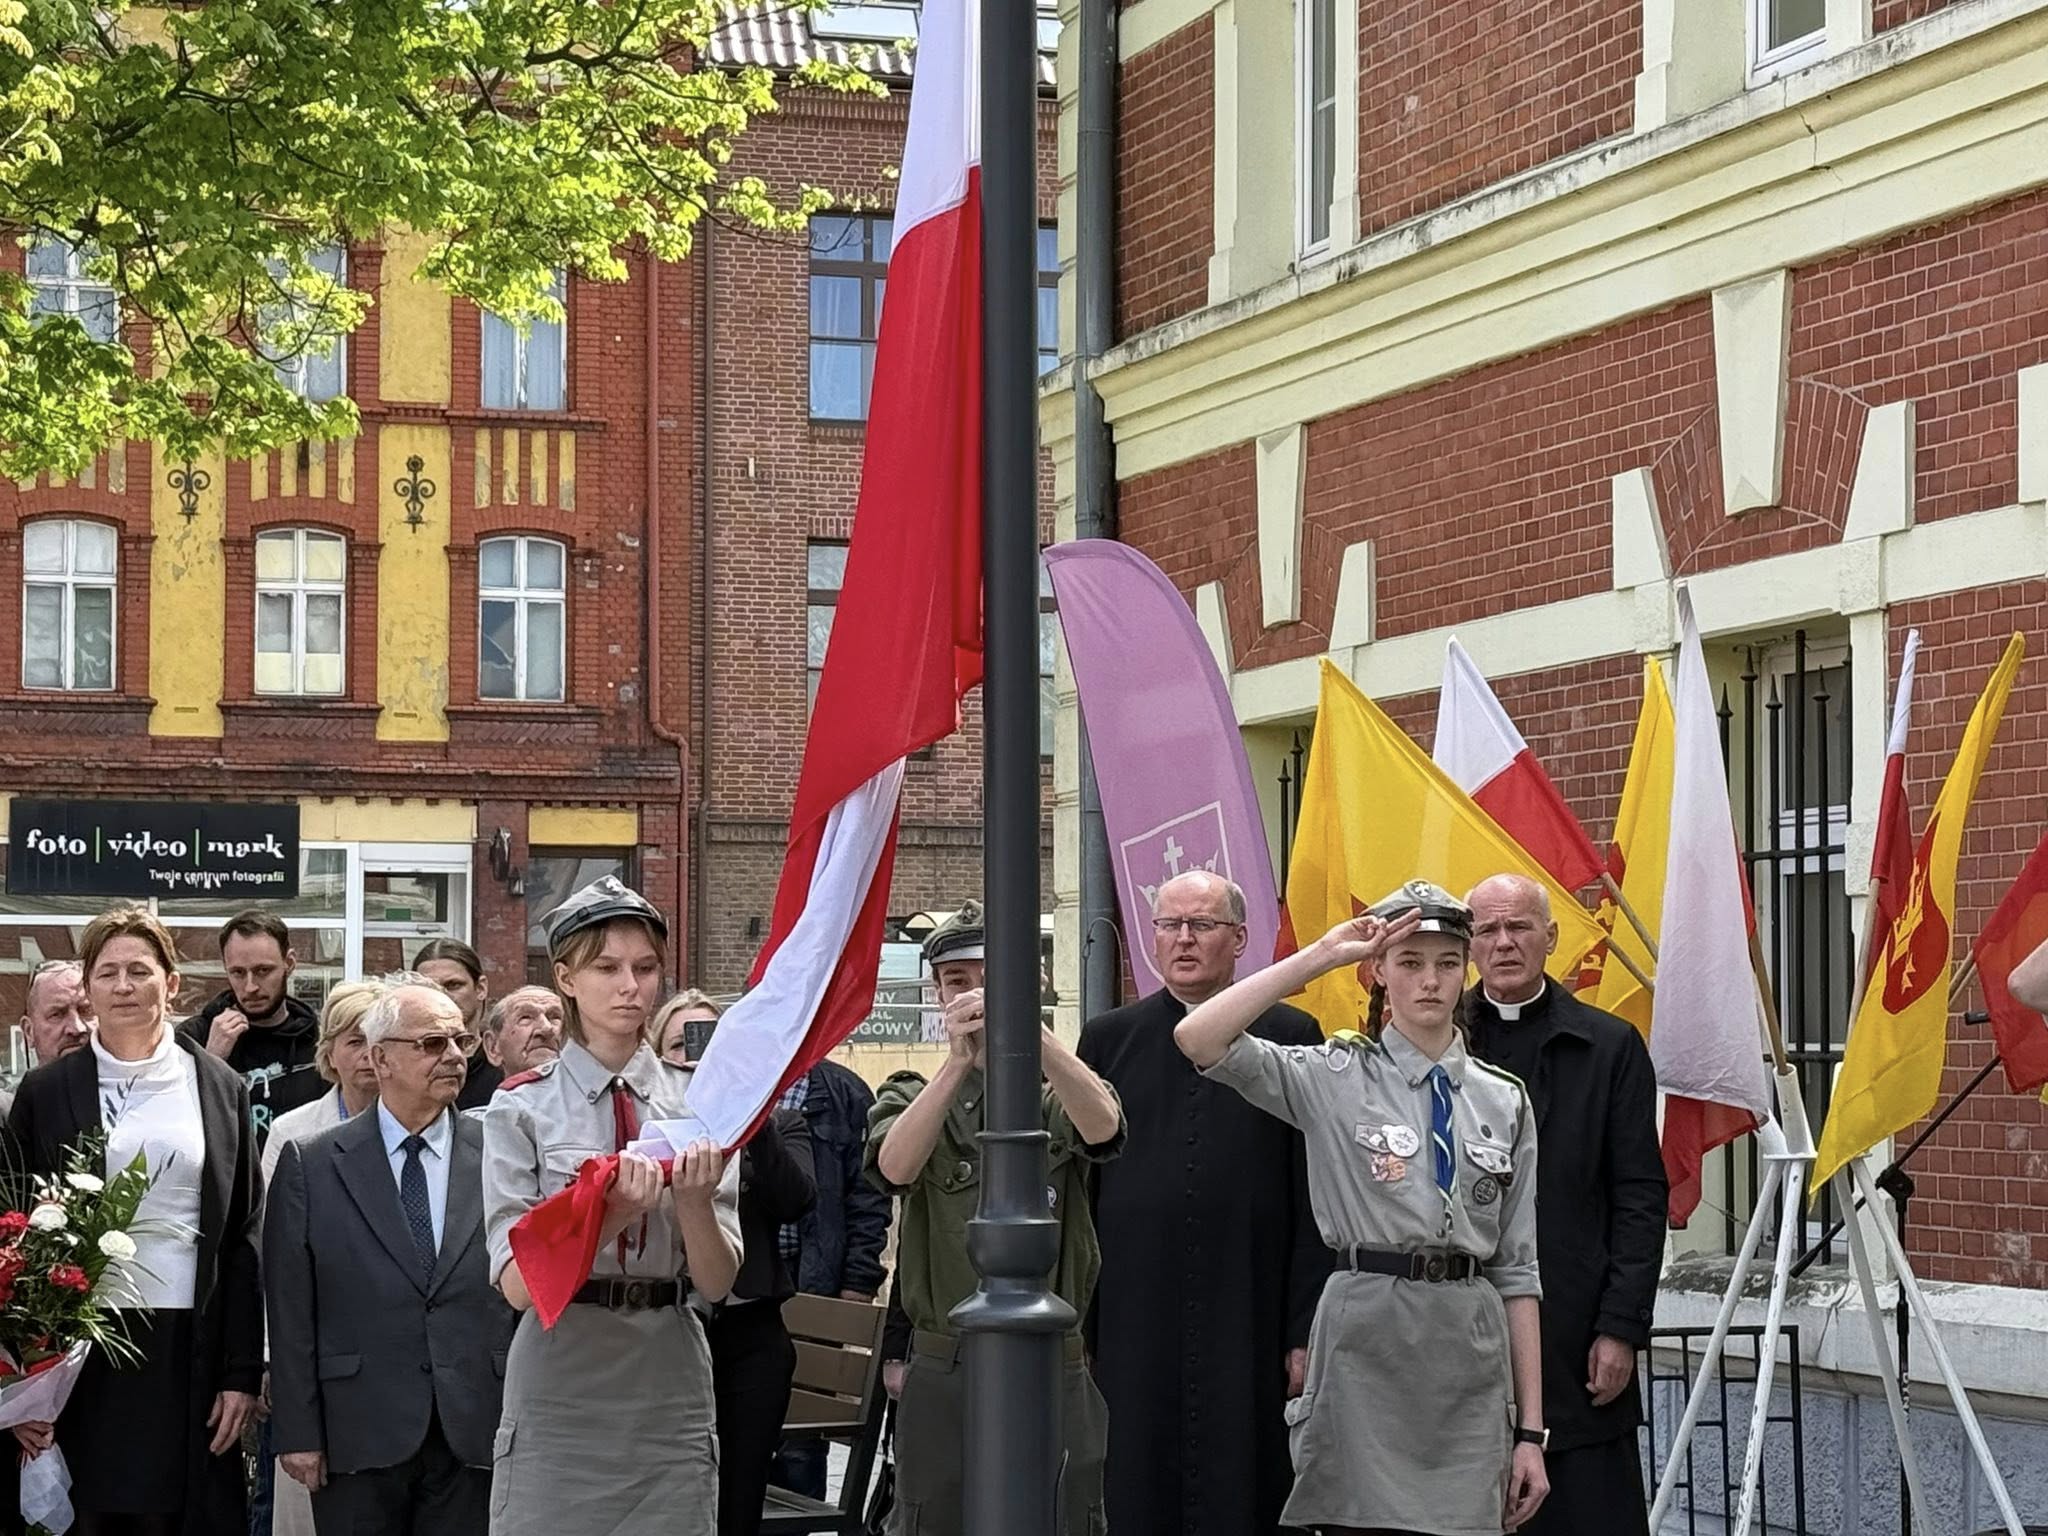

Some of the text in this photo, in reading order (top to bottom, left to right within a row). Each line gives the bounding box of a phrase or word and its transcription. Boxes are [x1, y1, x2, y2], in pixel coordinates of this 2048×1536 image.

[26, 829, 285, 859] foto video mark
[149, 869, 285, 888] Twoje centrum fotografii
